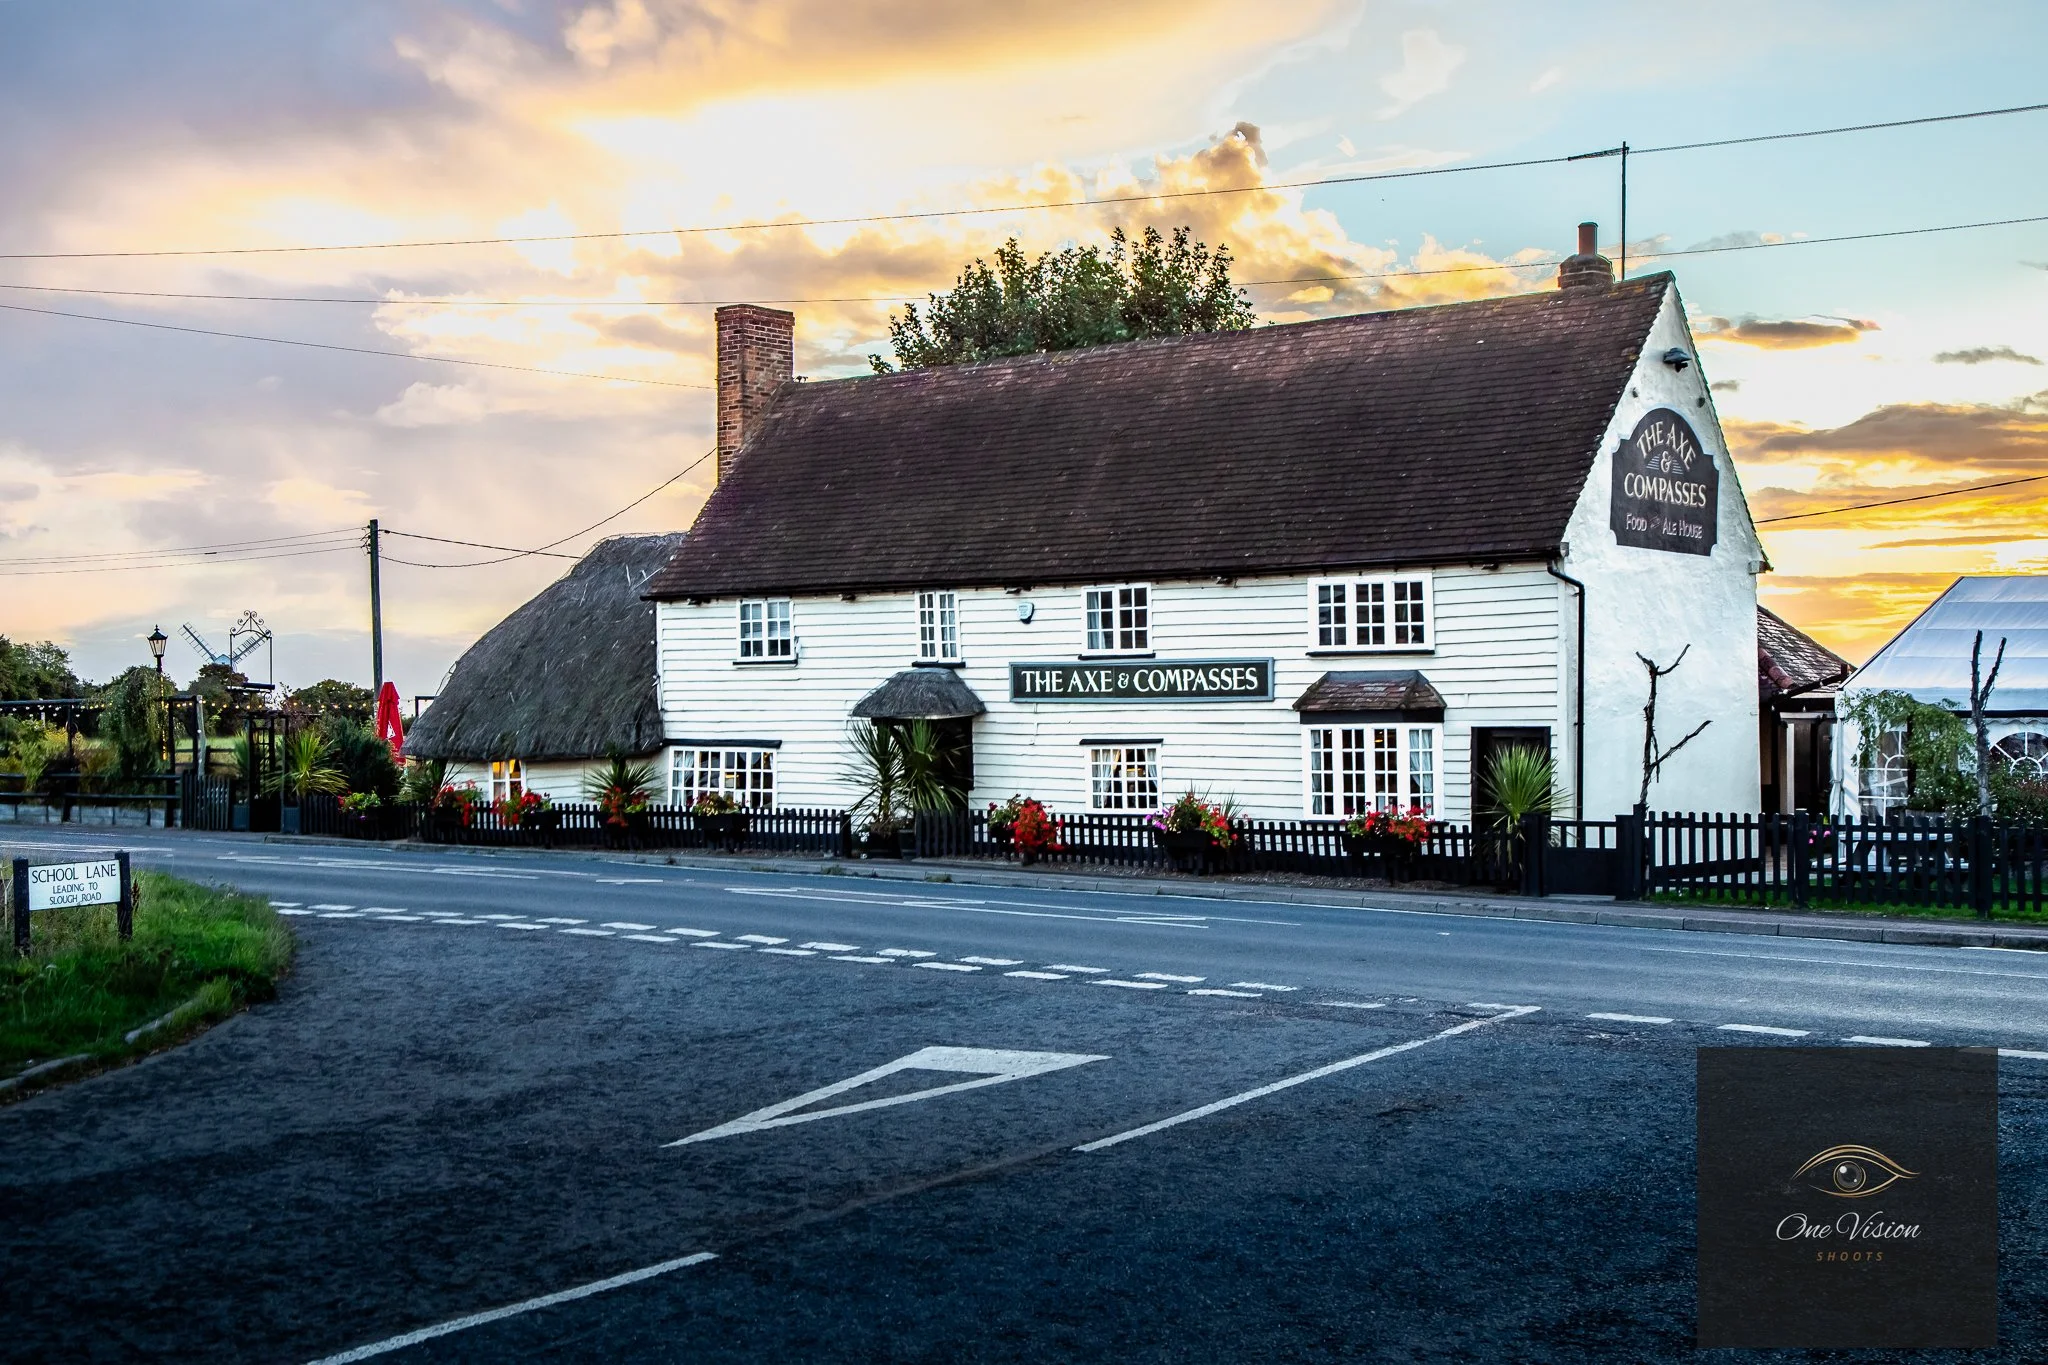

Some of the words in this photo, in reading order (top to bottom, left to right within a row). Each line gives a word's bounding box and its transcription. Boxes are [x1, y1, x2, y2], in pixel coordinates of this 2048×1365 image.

[1636, 421, 1664, 459] THE
[1666, 423, 1697, 472] AXE
[1660, 450, 1672, 473] &
[1624, 472, 1707, 507] COMPASSES
[1021, 670, 1063, 692] THE
[1067, 670, 1113, 692] AXE
[1117, 672, 1129, 689] &
[1133, 667, 1258, 692] COMPASSES
[31, 867, 79, 884] SCHOOL
[86, 863, 117, 879] LANE
[49, 894, 78, 906] SLOUGH
[81, 892, 102, 903] ROAD
[52, 883, 85, 895] LEADING
[89, 881, 98, 891] TO
